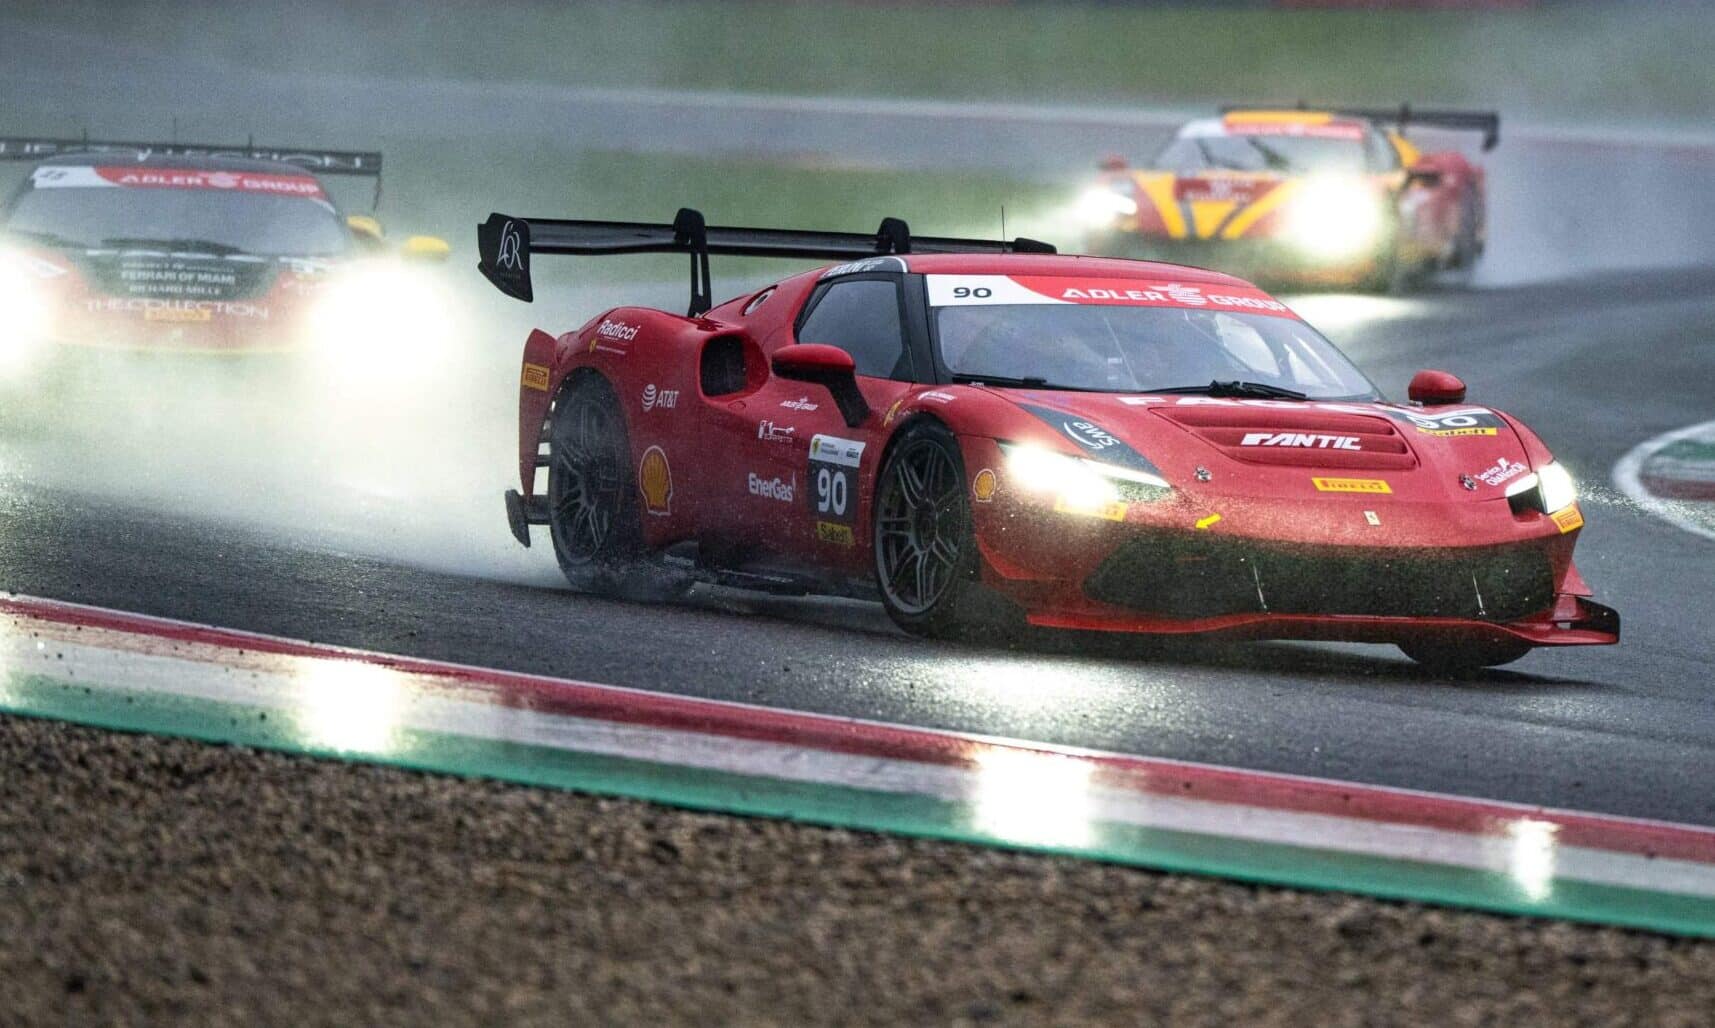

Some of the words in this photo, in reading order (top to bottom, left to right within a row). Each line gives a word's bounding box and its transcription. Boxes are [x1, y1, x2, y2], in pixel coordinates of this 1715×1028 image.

[120, 175, 203, 186] ADLER
[243, 178, 320, 193] GROUP
[121, 271, 176, 281] FERRARI
[197, 274, 235, 285] MIAMI
[953, 287, 992, 298] 90
[1062, 287, 1169, 302] ADLER
[1206, 294, 1288, 312] GROUP
[597, 319, 641, 341] Radicci
[656, 389, 679, 409] AT&T
[1073, 420, 1121, 447] aws
[1240, 432, 1361, 450] FANTIC
[748, 472, 794, 502] EnerGas
[818, 468, 847, 516] 90
